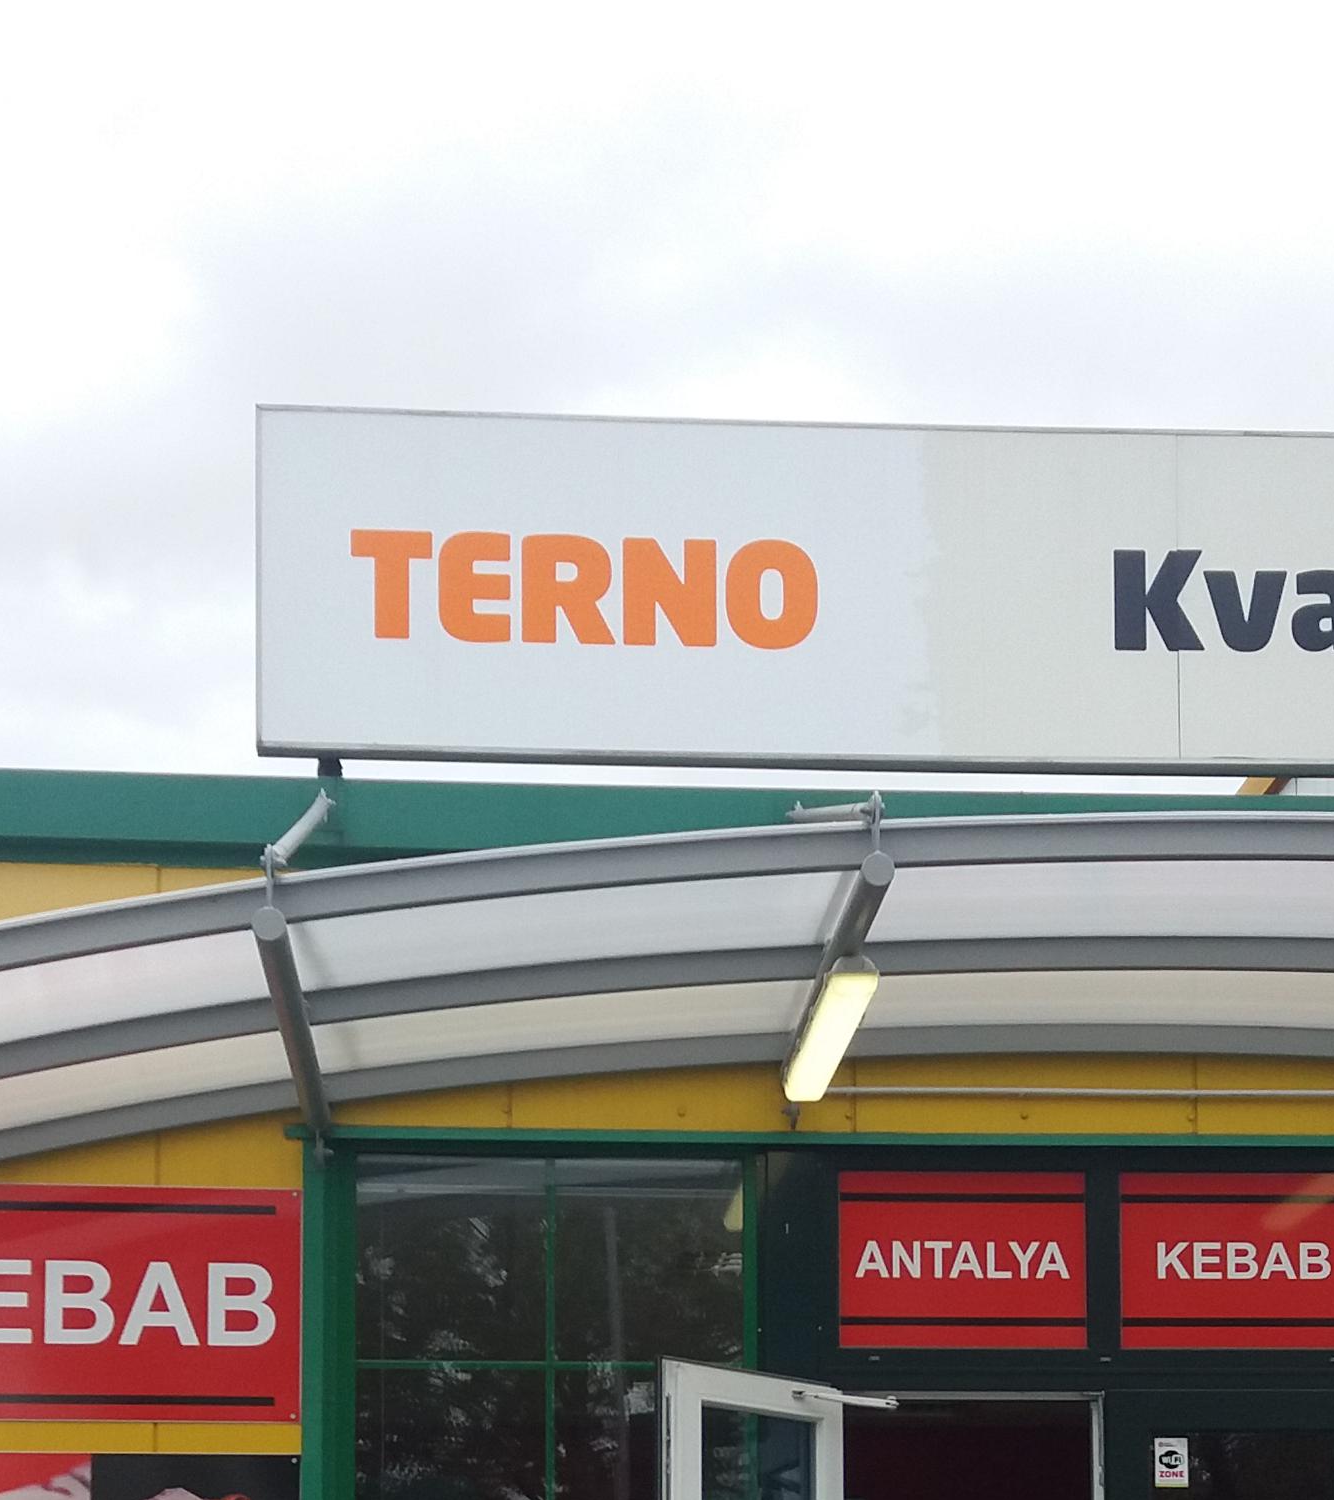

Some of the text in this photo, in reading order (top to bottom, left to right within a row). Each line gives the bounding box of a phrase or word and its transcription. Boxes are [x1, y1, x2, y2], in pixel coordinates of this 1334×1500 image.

[350, 528, 819, 651] TERNO
[855, 1240, 1071, 1279] ANTALYA
[1156, 1241, 1332, 1280] KEBAB
[1158, 1470, 1185, 1478] ZONE
